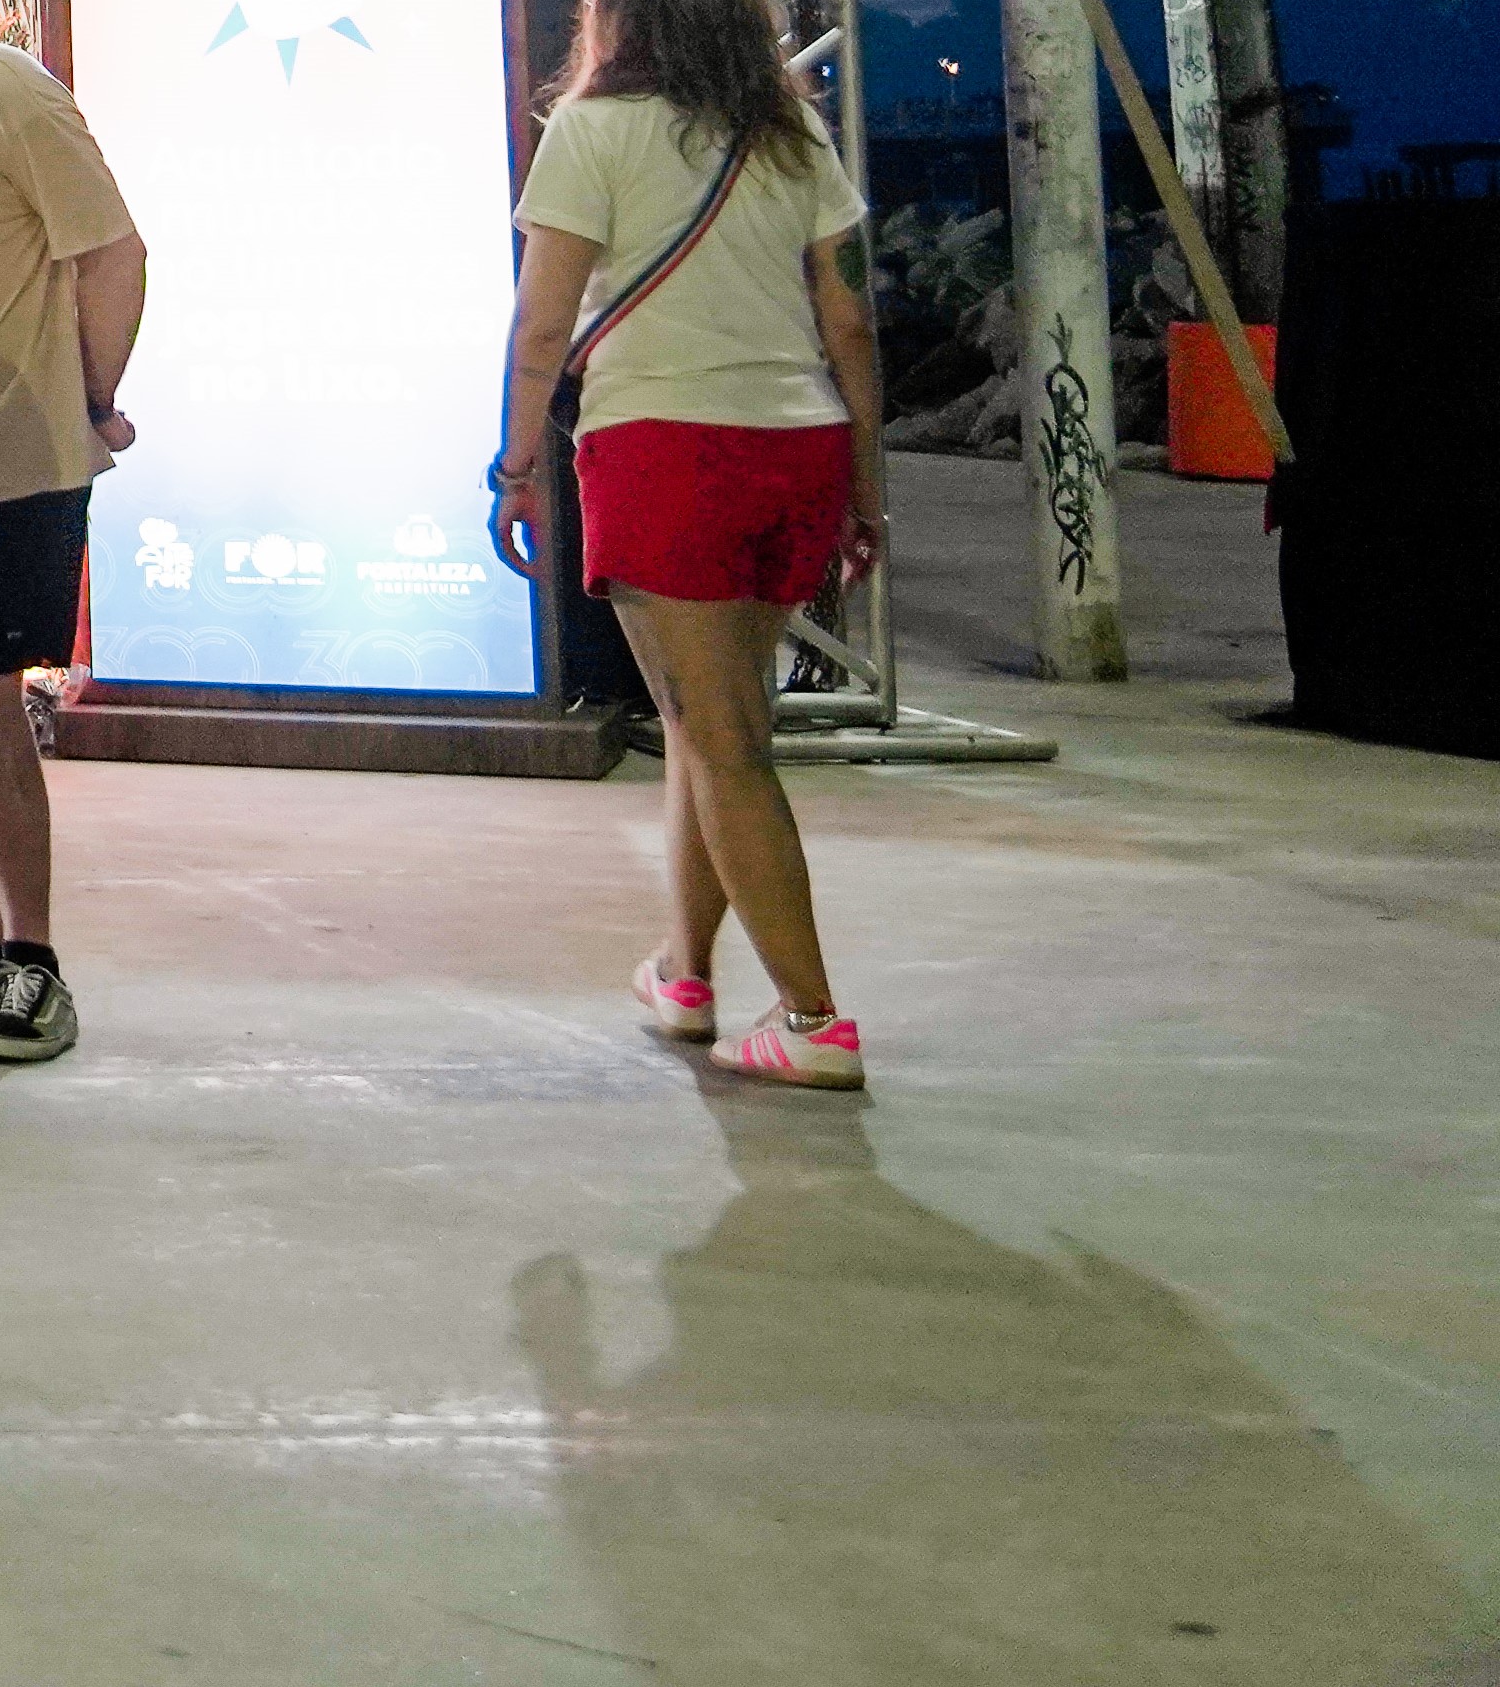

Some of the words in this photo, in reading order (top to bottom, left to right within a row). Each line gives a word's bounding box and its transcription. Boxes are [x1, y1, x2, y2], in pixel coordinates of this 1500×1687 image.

[146, 132, 282, 195] Aqui
[301, 130, 449, 181] todo
[159, 187, 379, 236] mundo
[157, 298, 304, 362] joga
[319, 308, 361, 347] o
[188, 363, 268, 403] no
[281, 351, 420, 403] lixo.
[356, 561, 487, 582] FORTALEZA
